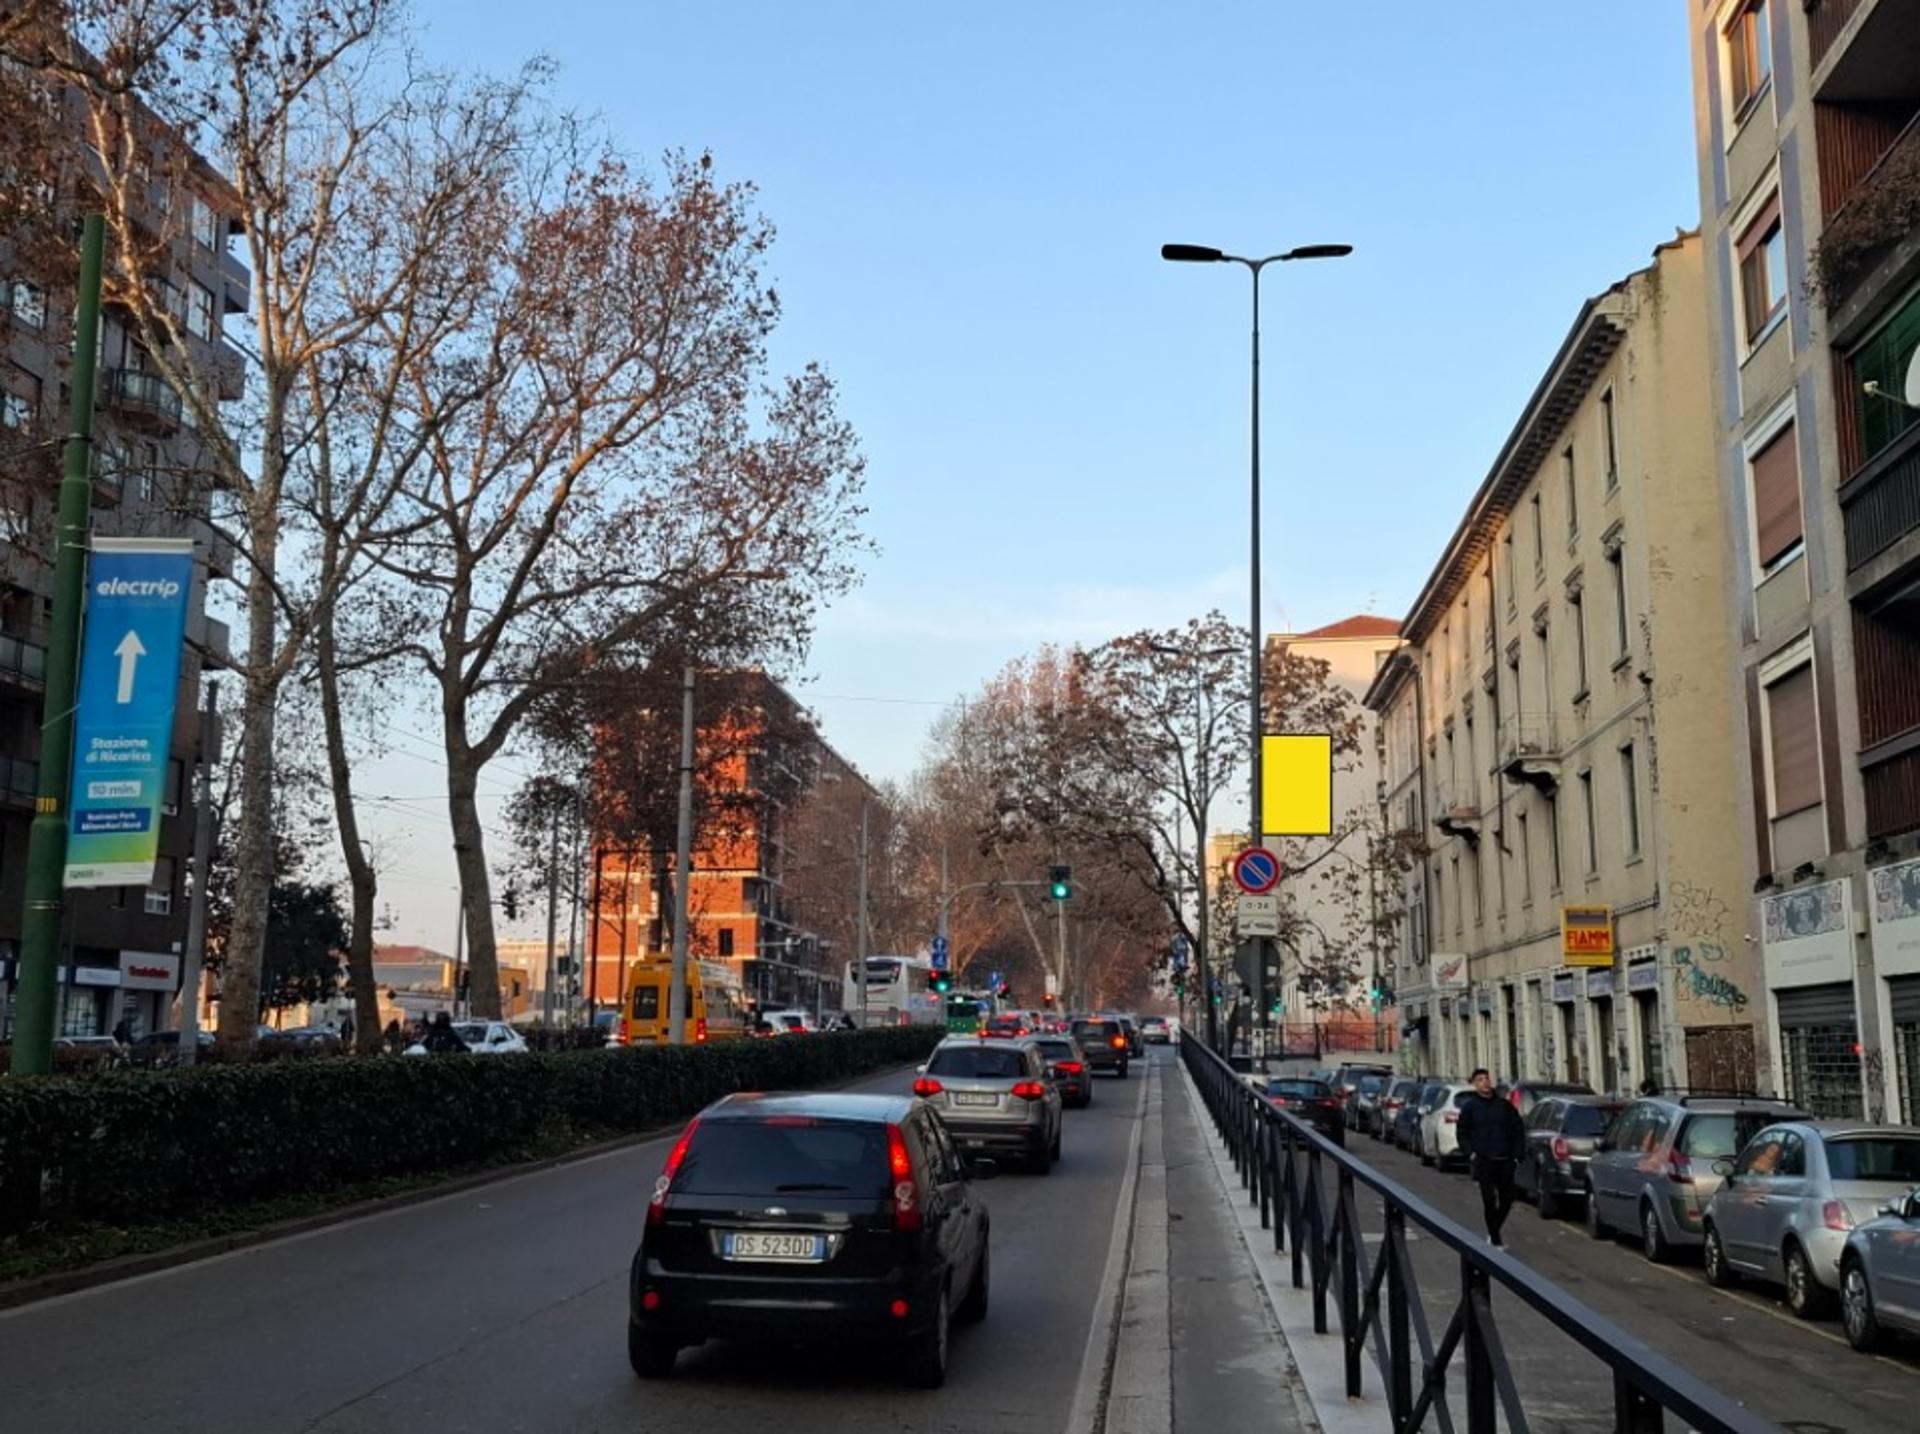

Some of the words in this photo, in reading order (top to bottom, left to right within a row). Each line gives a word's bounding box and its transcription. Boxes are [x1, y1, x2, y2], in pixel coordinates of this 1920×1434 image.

[97, 577, 179, 598] electrip
[91, 736, 148, 749] Stazione
[86, 751, 98, 763] di
[100, 749, 151, 763] Ricarica
[1566, 930, 1610, 949] FIAMM
[735, 1236, 755, 1253] DS
[761, 1236, 813, 1255] 523DD
